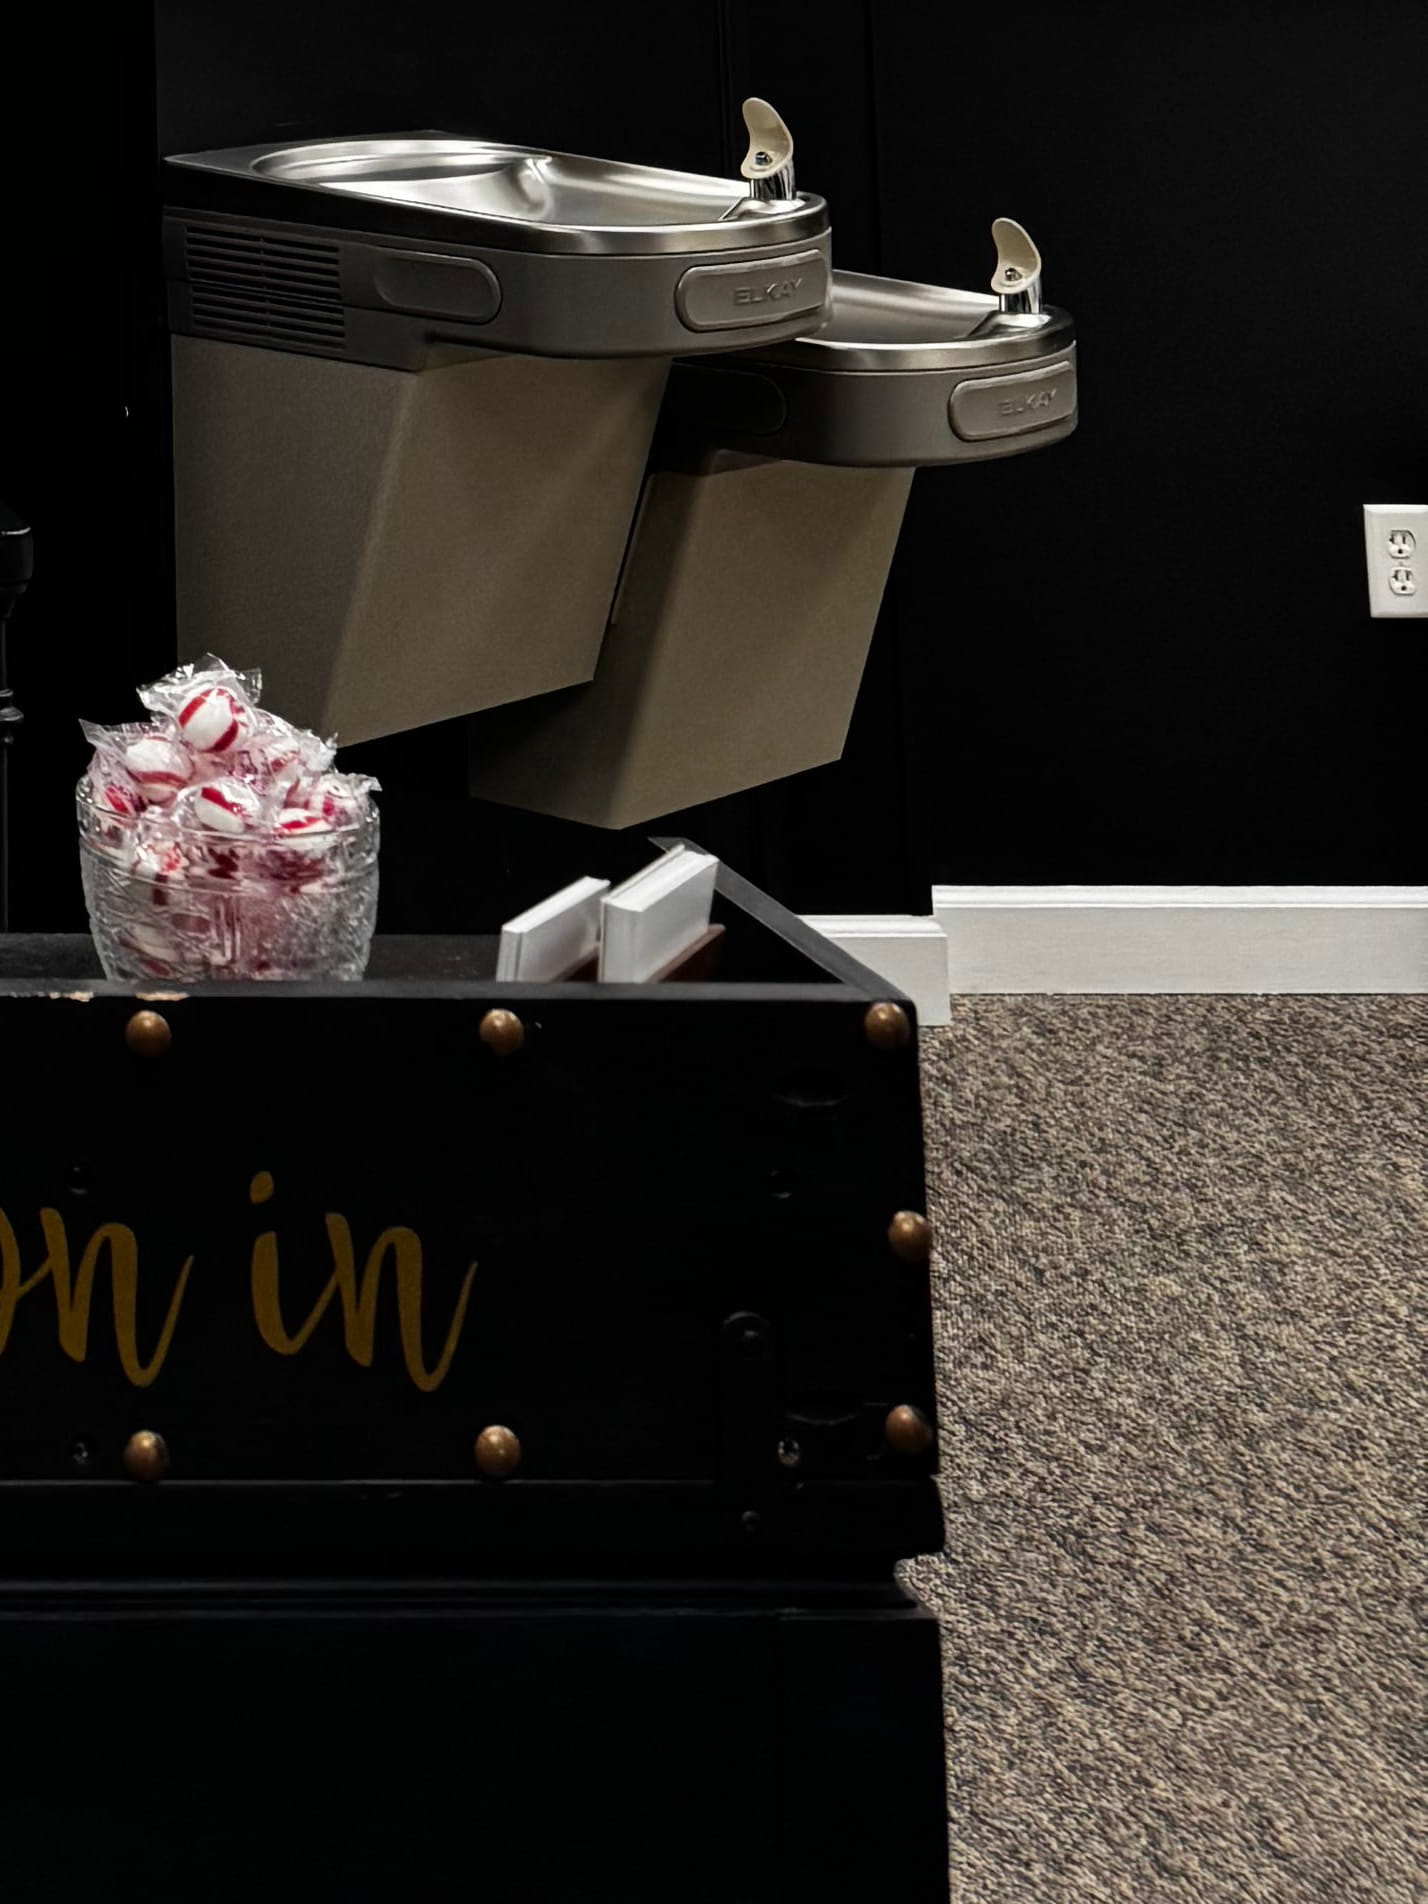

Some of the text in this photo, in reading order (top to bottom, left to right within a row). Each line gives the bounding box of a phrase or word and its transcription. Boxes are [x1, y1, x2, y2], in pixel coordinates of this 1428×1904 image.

[733, 278, 802, 306] ELKAY
[998, 389, 1057, 416] ELKAY
[249, 1171, 477, 1392] in
